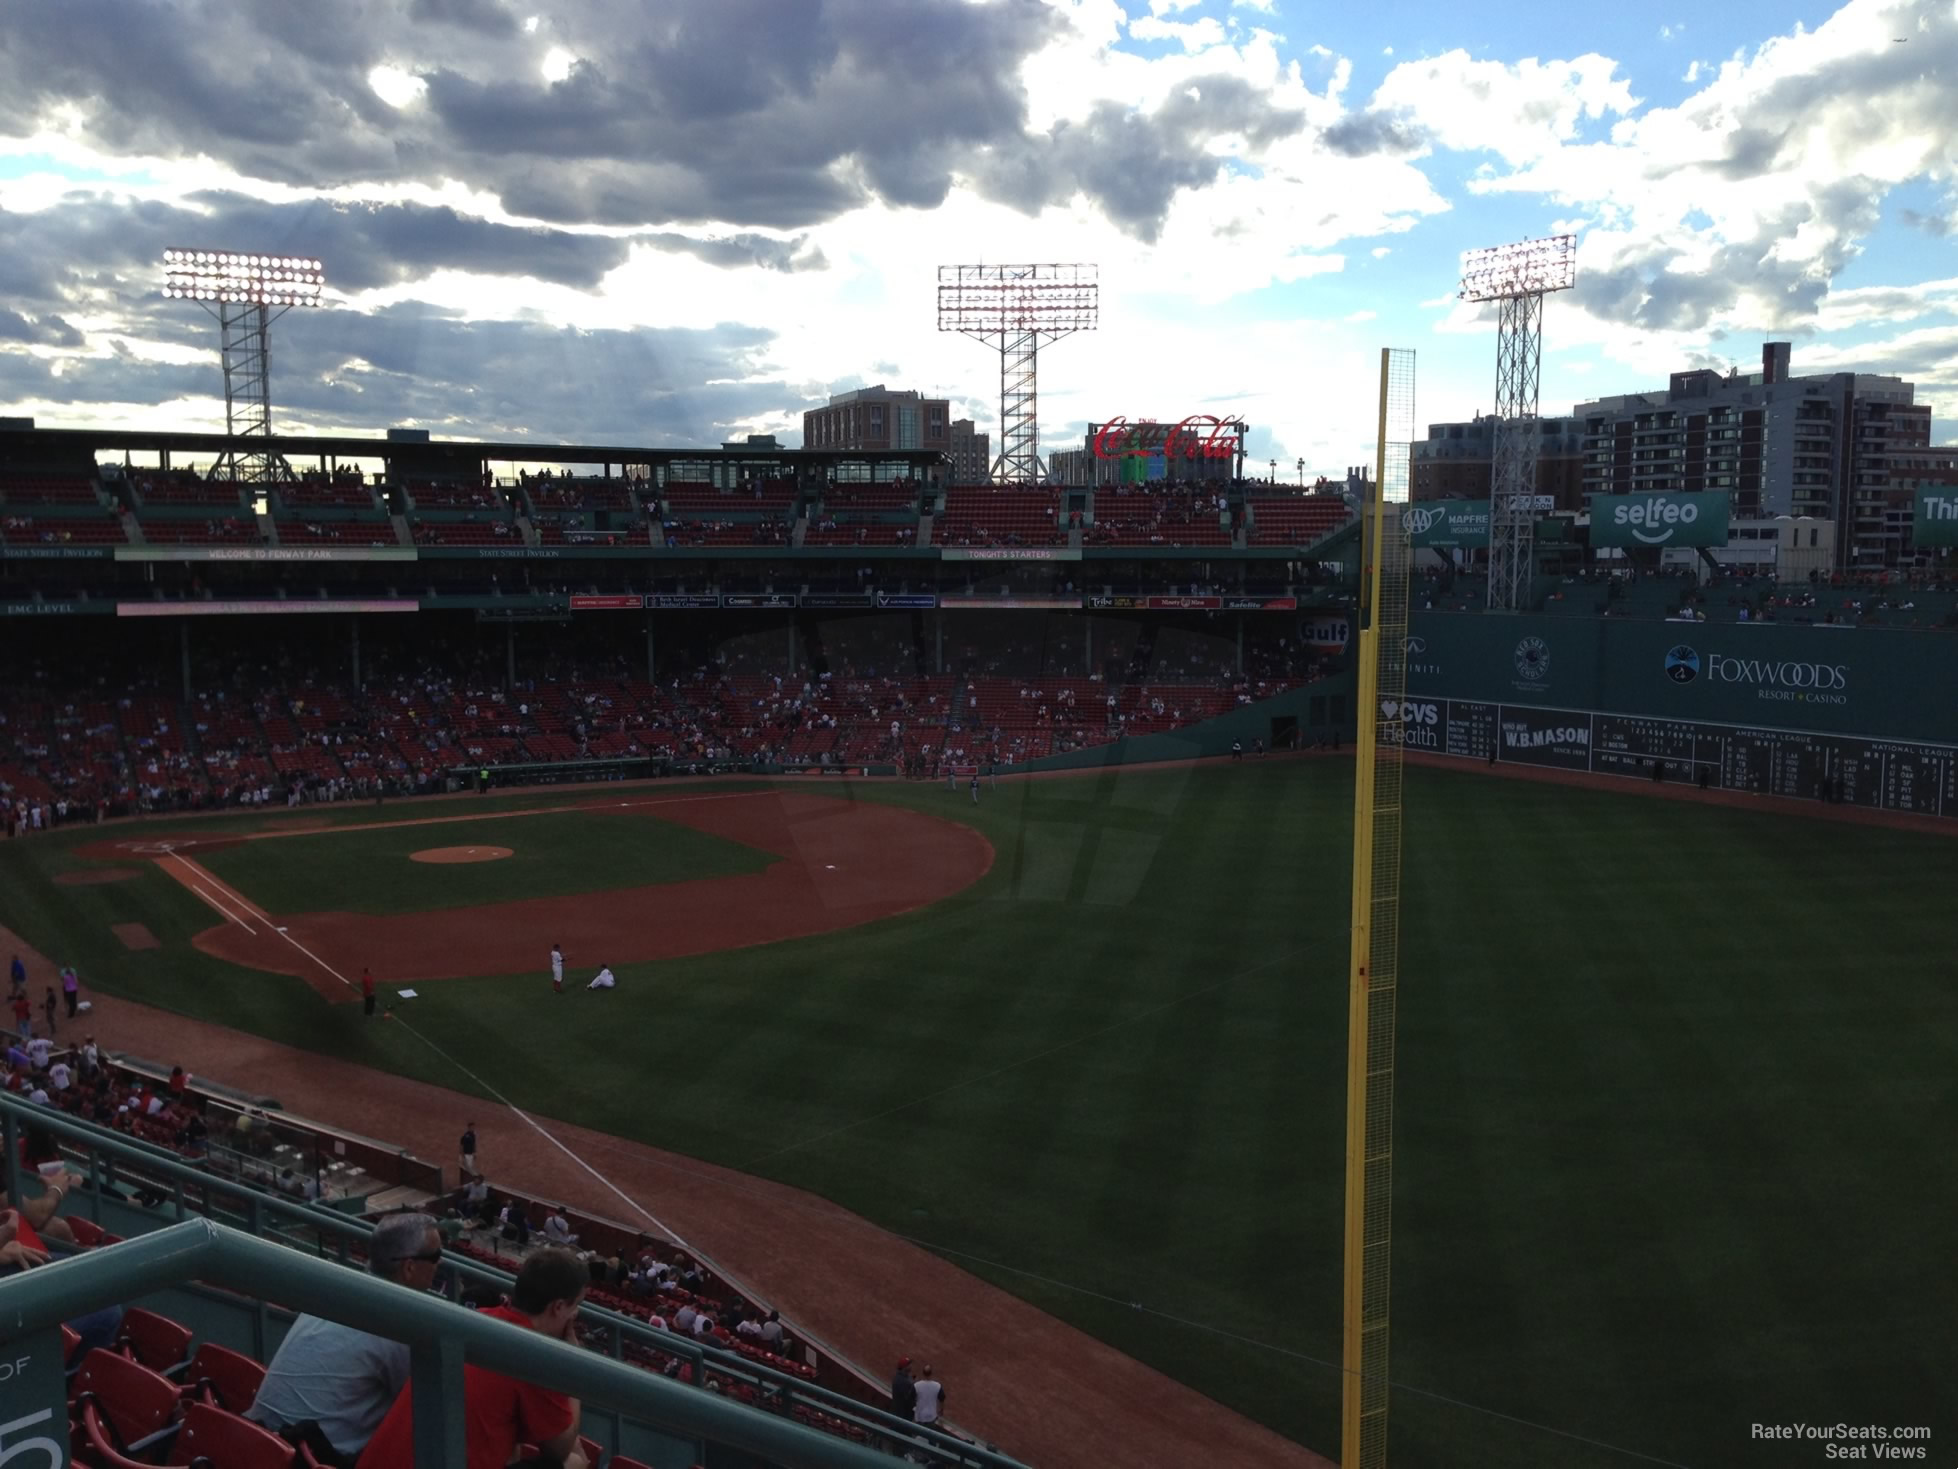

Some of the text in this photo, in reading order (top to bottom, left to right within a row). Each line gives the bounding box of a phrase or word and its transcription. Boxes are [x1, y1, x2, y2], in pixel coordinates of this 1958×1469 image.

[1404, 509, 1432, 534] AAA
[1448, 515, 1489, 524] MAPFRE
[1451, 526, 1485, 534] INSURANCE
[4, 548, 29, 558] STATE
[209, 550, 330, 559] WELCOME TO FENWAY PARK
[1010, 550, 1050, 559] STARTERS
[8, 604, 74, 614] EMC LEVEL
[1301, 622, 1347, 641] Gulf
[1707, 653, 1846, 690] FOXWOODS
[1758, 689, 1847, 705] RESORT CASINO
[1400, 702, 1438, 725] CVS
[1666, 723, 1695, 731] PARK
[1383, 722, 1438, 747] Health
[1735, 730, 1812, 743] AMERICAN LEAGUE
[1872, 743, 1955, 758] NATIONAL LEAGUE
